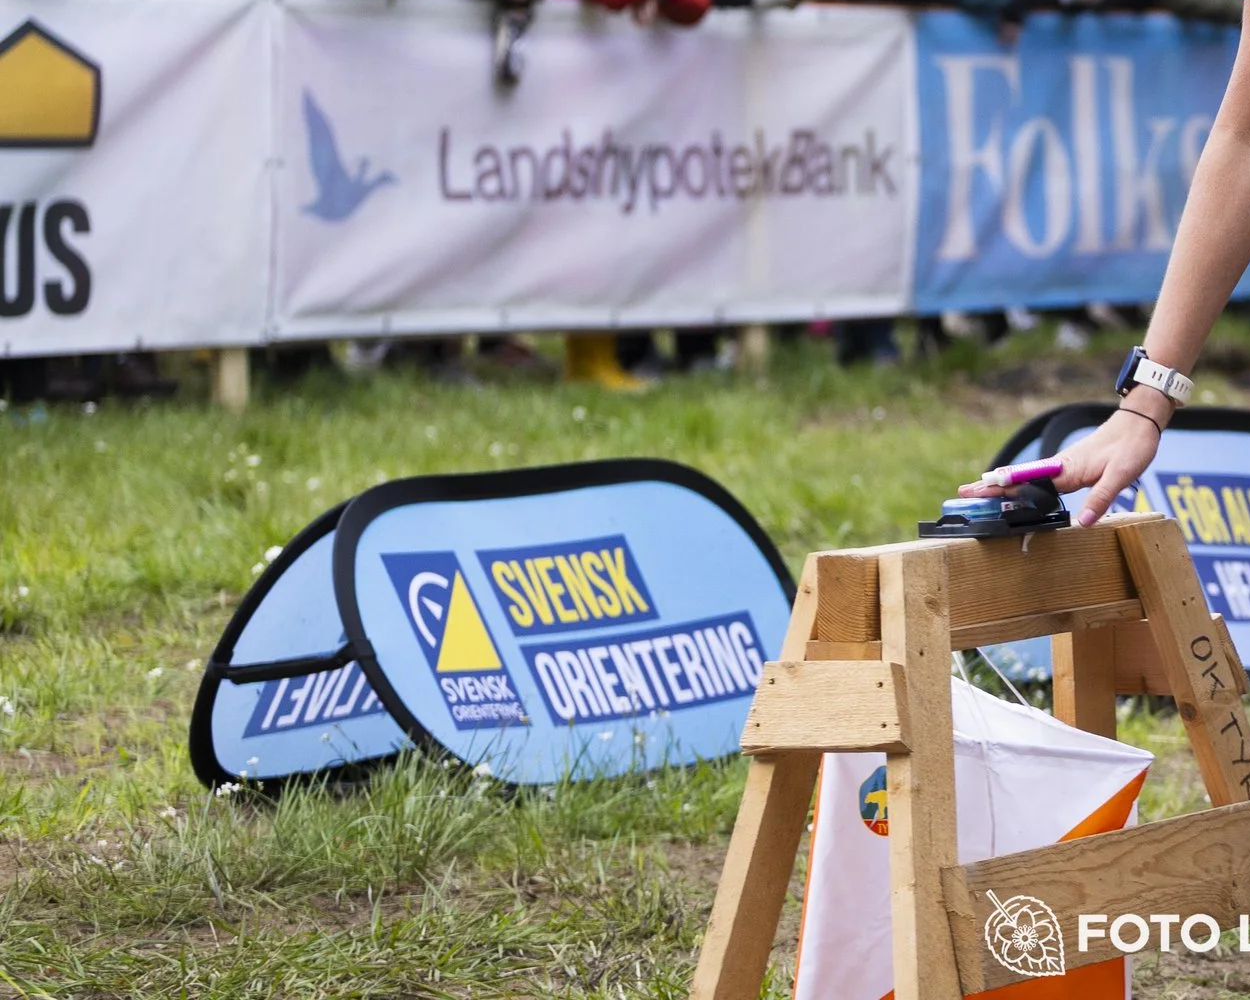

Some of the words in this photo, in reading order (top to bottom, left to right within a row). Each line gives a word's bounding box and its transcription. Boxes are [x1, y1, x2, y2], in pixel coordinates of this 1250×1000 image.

[1166, 475, 1231, 544] FÖR
[491, 546, 650, 628] SVENSK
[440, 673, 516, 703] SVENSK
[534, 621, 760, 720] ORIENTERING
